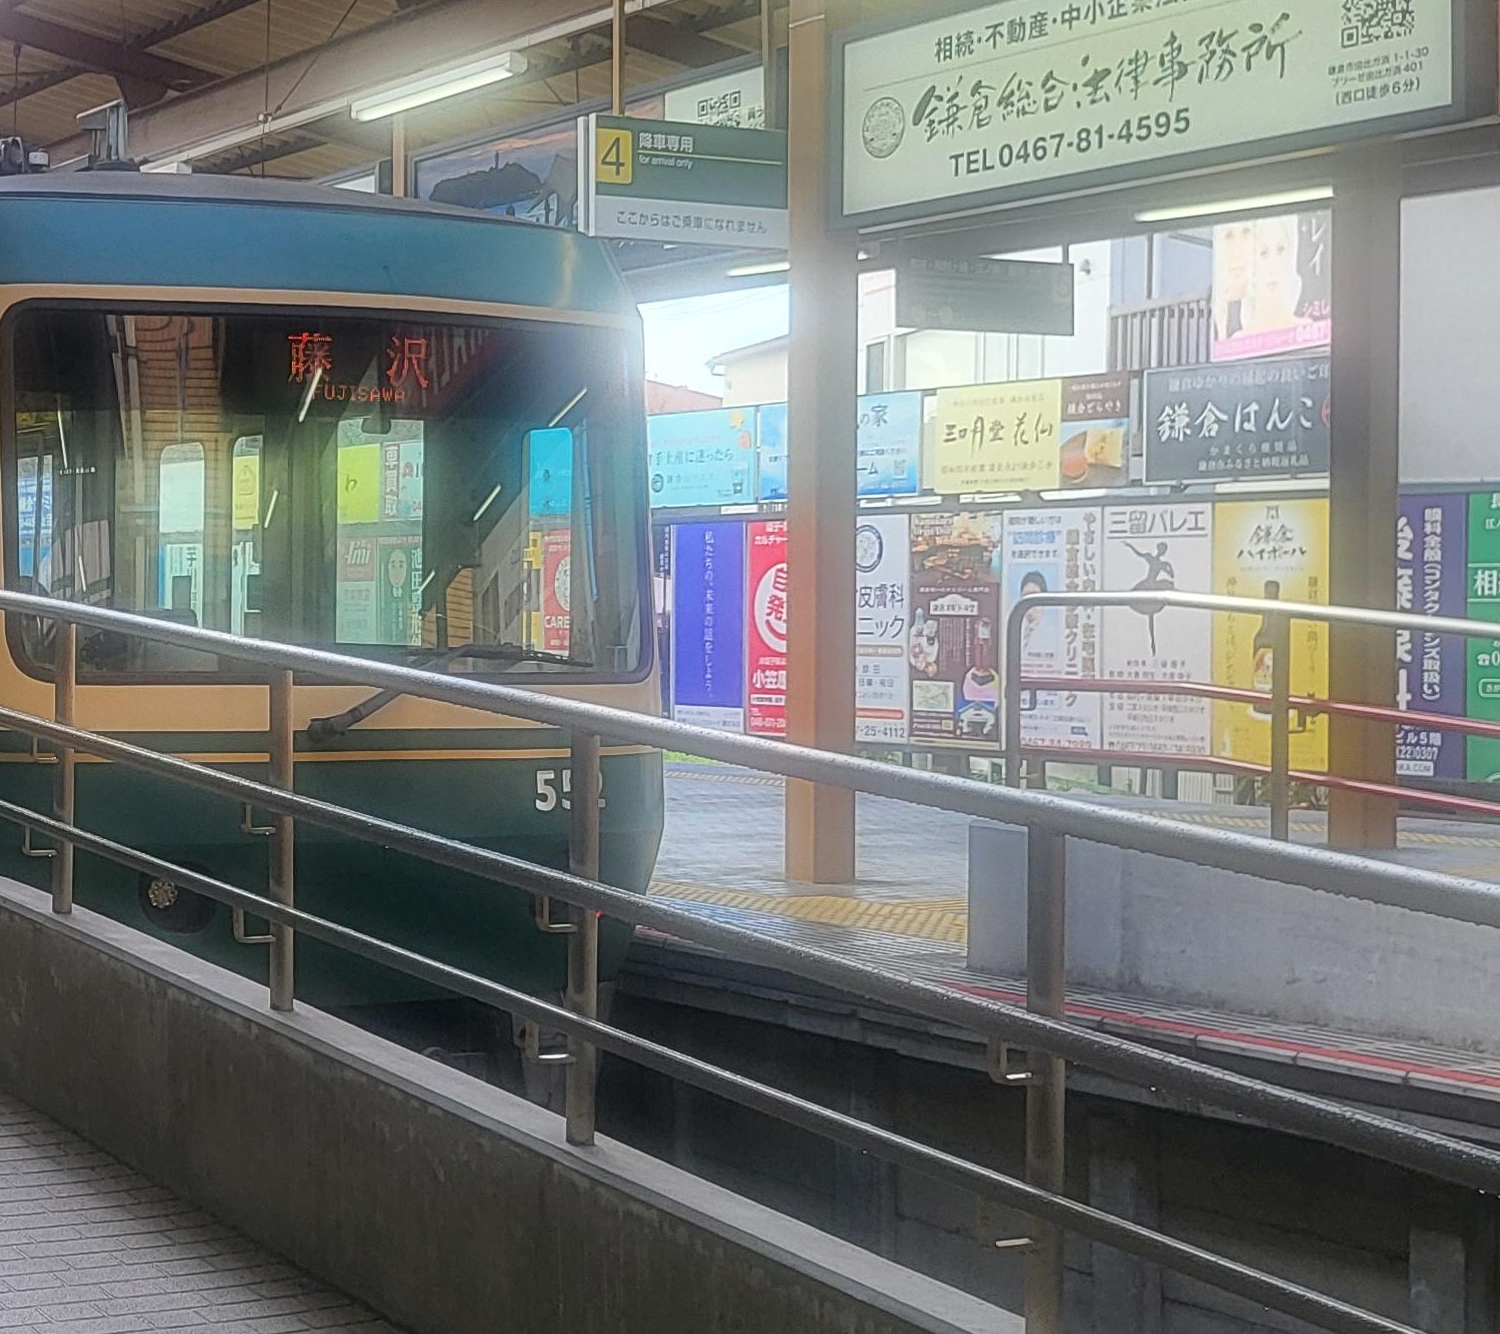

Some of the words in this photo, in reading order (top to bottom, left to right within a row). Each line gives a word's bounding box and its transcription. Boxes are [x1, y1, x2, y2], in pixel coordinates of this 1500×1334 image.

[912, 12, 1302, 144] 鎌倉総合法律事務所
[638, 132, 694, 153] 降車専用
[600, 136, 626, 177] 4
[638, 154, 651, 165] for
[651, 156, 675, 167] arrival
[675, 159, 694, 171] only
[616, 210, 767, 235] ここからはご乗車になれません
[287, 332, 429, 388] 藤沢
[312, 384, 406, 402] FUJISAWA
[1157, 397, 1315, 444] 鎌倉はんこ
[1109, 510, 1206, 534] 三留バレエ
[1474, 569, 1500, 597] 相
[858, 583, 905, 609] 皮膚科
[856, 725, 906, 738] -25-4112
